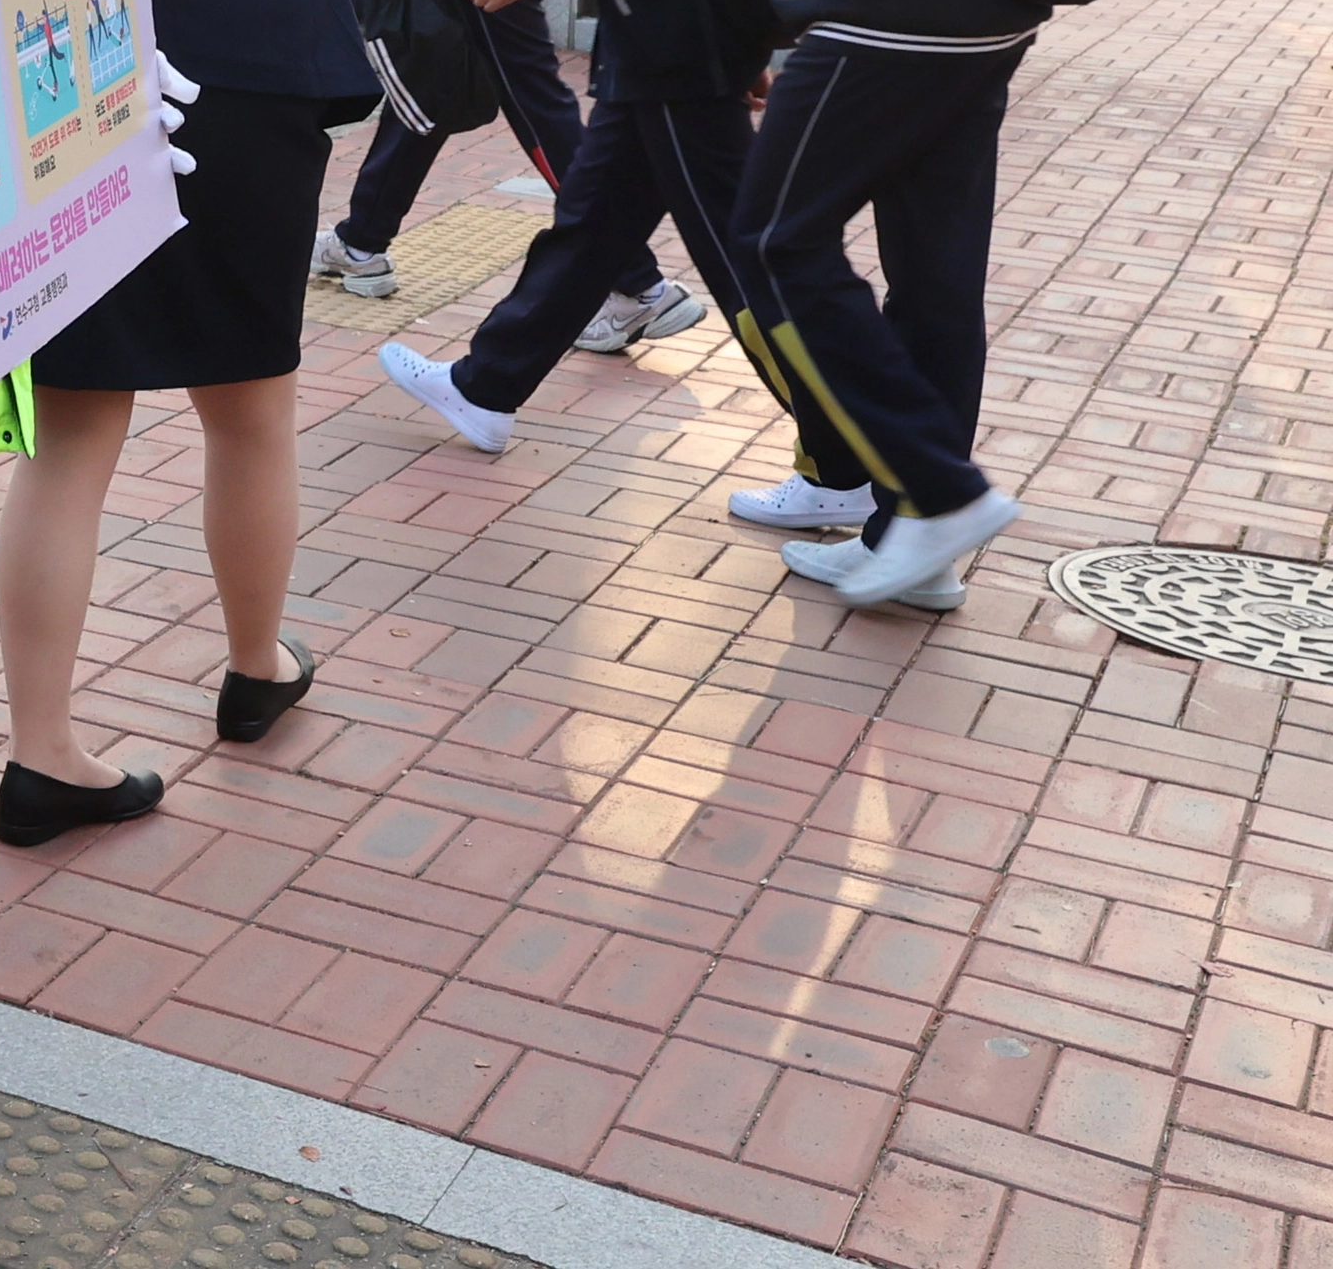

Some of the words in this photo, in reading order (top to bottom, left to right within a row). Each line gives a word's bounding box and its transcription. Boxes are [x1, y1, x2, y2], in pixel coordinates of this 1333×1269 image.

[50, 196, 88, 253] 문화를
[86, 164, 131, 225] 만들어요
[14, 295, 40, 326] 연수구청
[39, 272, 68, 309] 교통행정과
